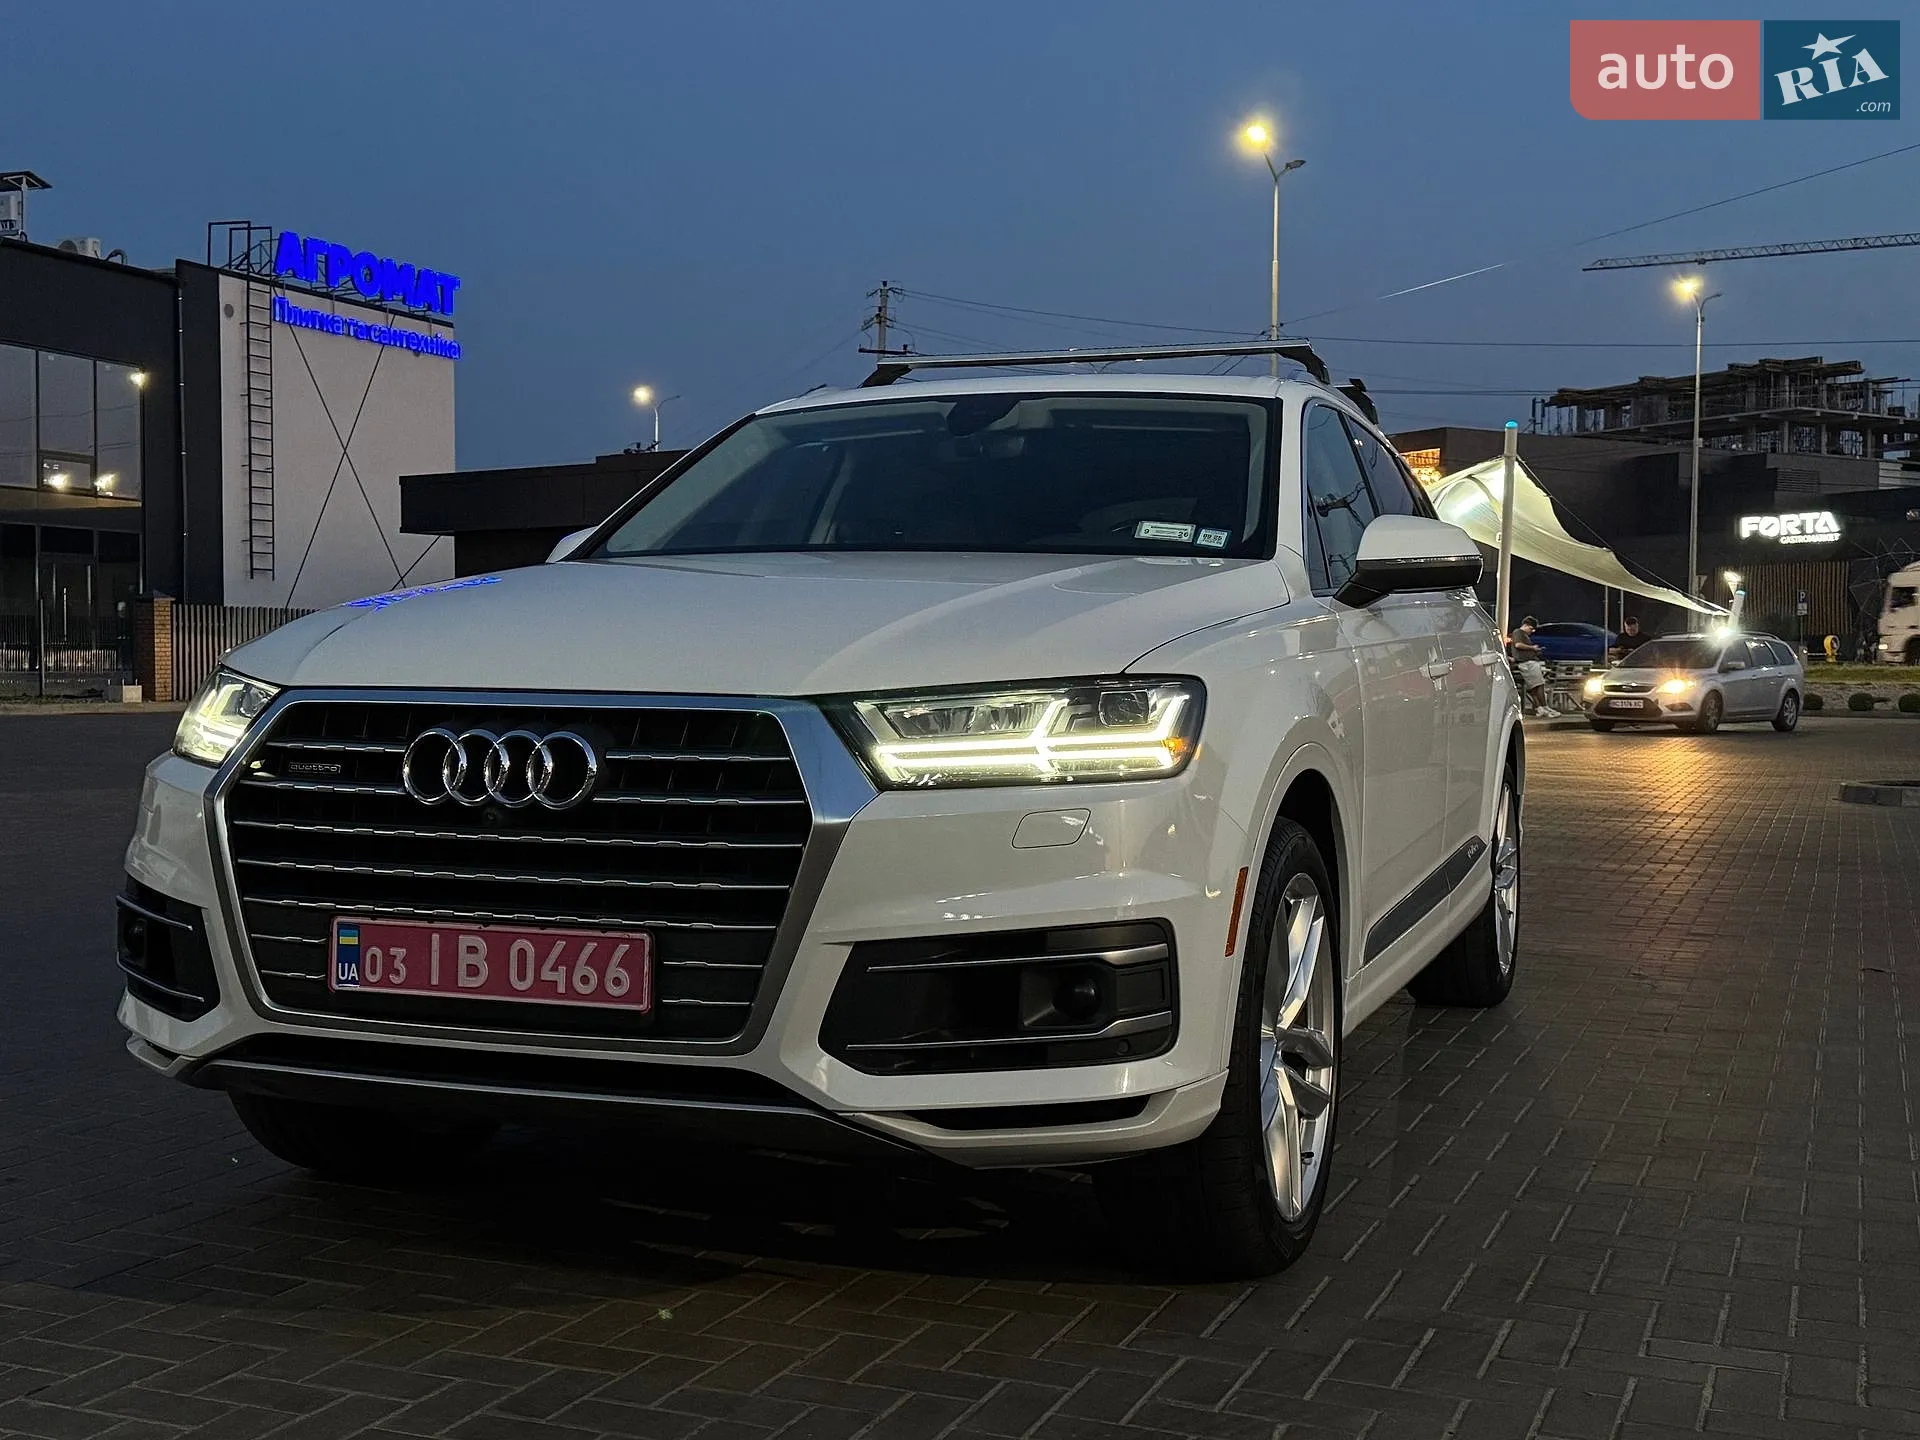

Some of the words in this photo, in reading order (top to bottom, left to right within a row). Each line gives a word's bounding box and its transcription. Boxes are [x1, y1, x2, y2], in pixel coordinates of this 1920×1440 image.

[273, 231, 461, 316] АГРОМАТ
[273, 296, 344, 336] Плитка
[345, 317, 369, 341] та
[370, 322, 461, 360] сантехніка
[338, 962, 359, 981] UA
[364, 946, 408, 985] 03
[508, 938, 631, 998] 0466
